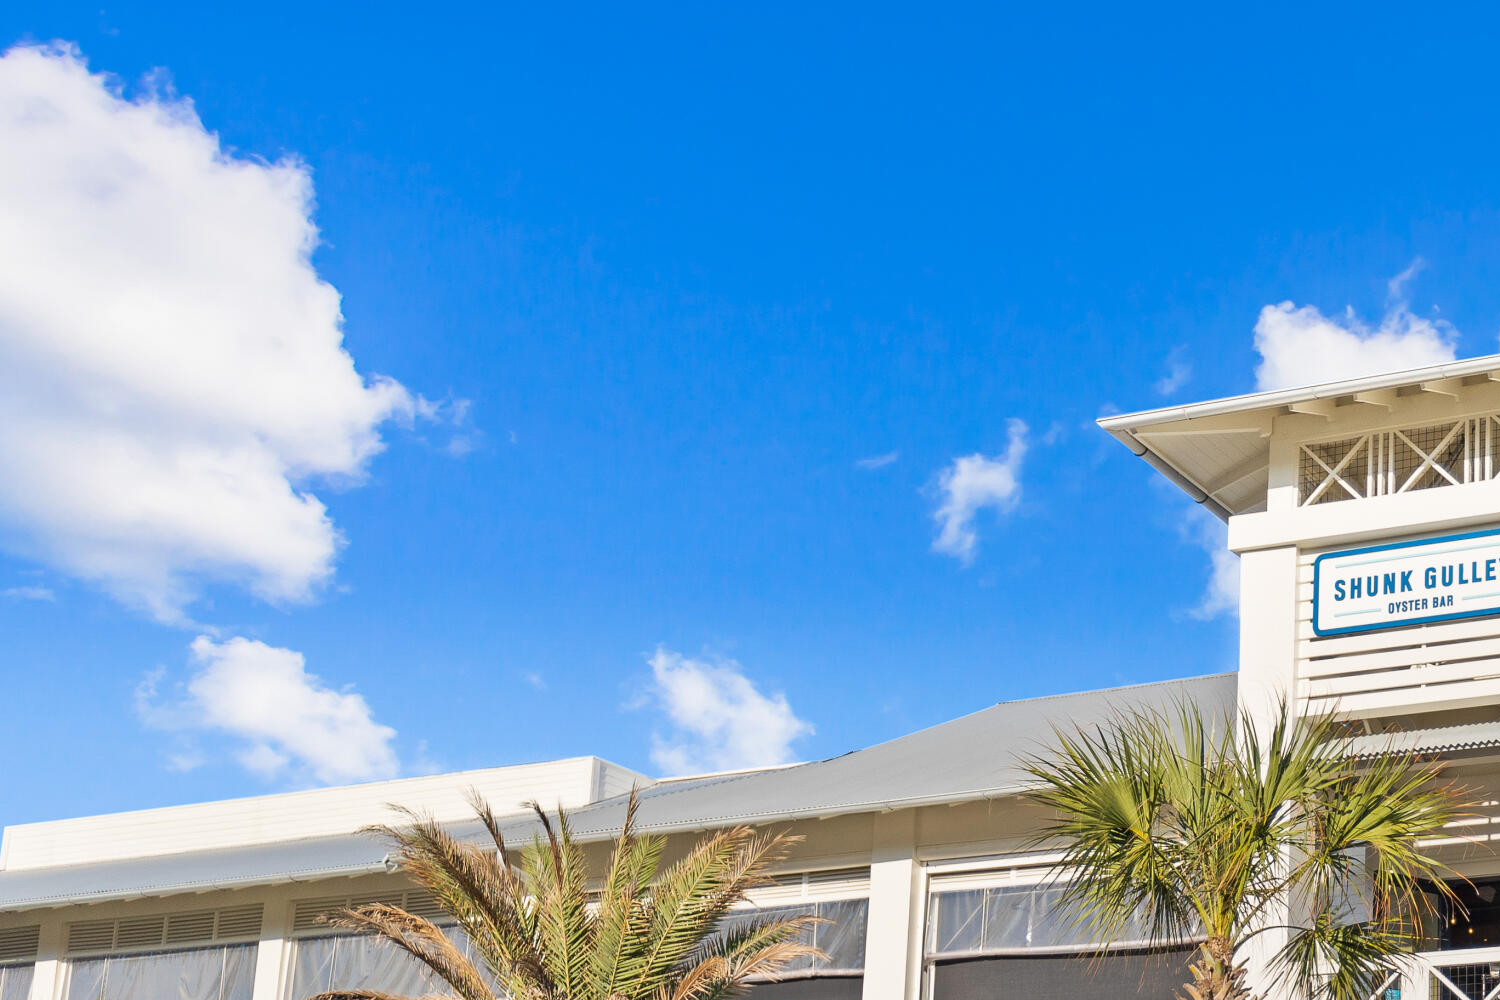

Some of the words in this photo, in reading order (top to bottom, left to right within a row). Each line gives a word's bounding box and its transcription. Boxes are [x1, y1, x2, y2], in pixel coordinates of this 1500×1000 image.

[1334, 569, 1413, 601] SHUNK
[1388, 598, 1428, 614] OYSTER
[1432, 595, 1454, 609] BAR
